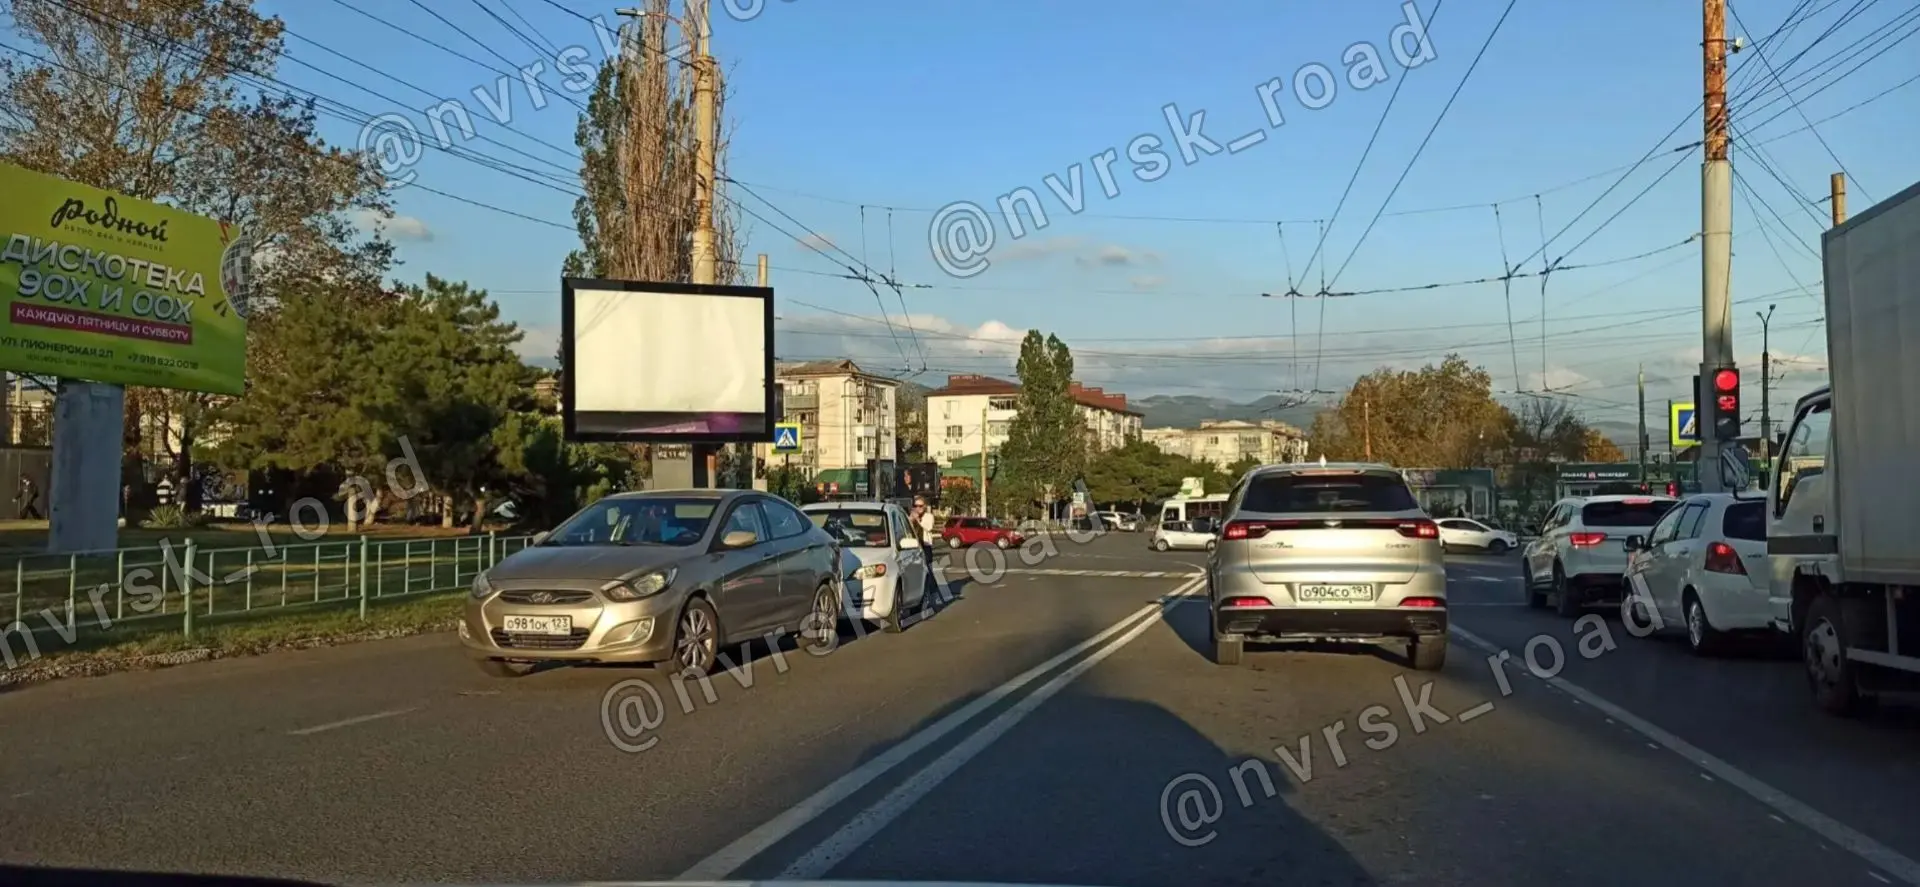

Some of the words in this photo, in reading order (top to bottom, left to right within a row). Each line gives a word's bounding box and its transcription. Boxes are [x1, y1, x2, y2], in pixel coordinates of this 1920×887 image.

[51, 195, 169, 242] родной
[0, 232, 206, 298] ДИСКОТЕКА
[99, 284, 124, 312] И
[16, 307, 75, 323] КАЖДУЮ
[77, 315, 129, 332] ПЯТНИЦУ
[131, 323, 140, 334] И
[142, 325, 189, 340] СУББОТУ
[1303, 586, 1350, 598] О904СО
[1351, 585, 1368, 595] 193
[551, 617, 568, 629] 123
